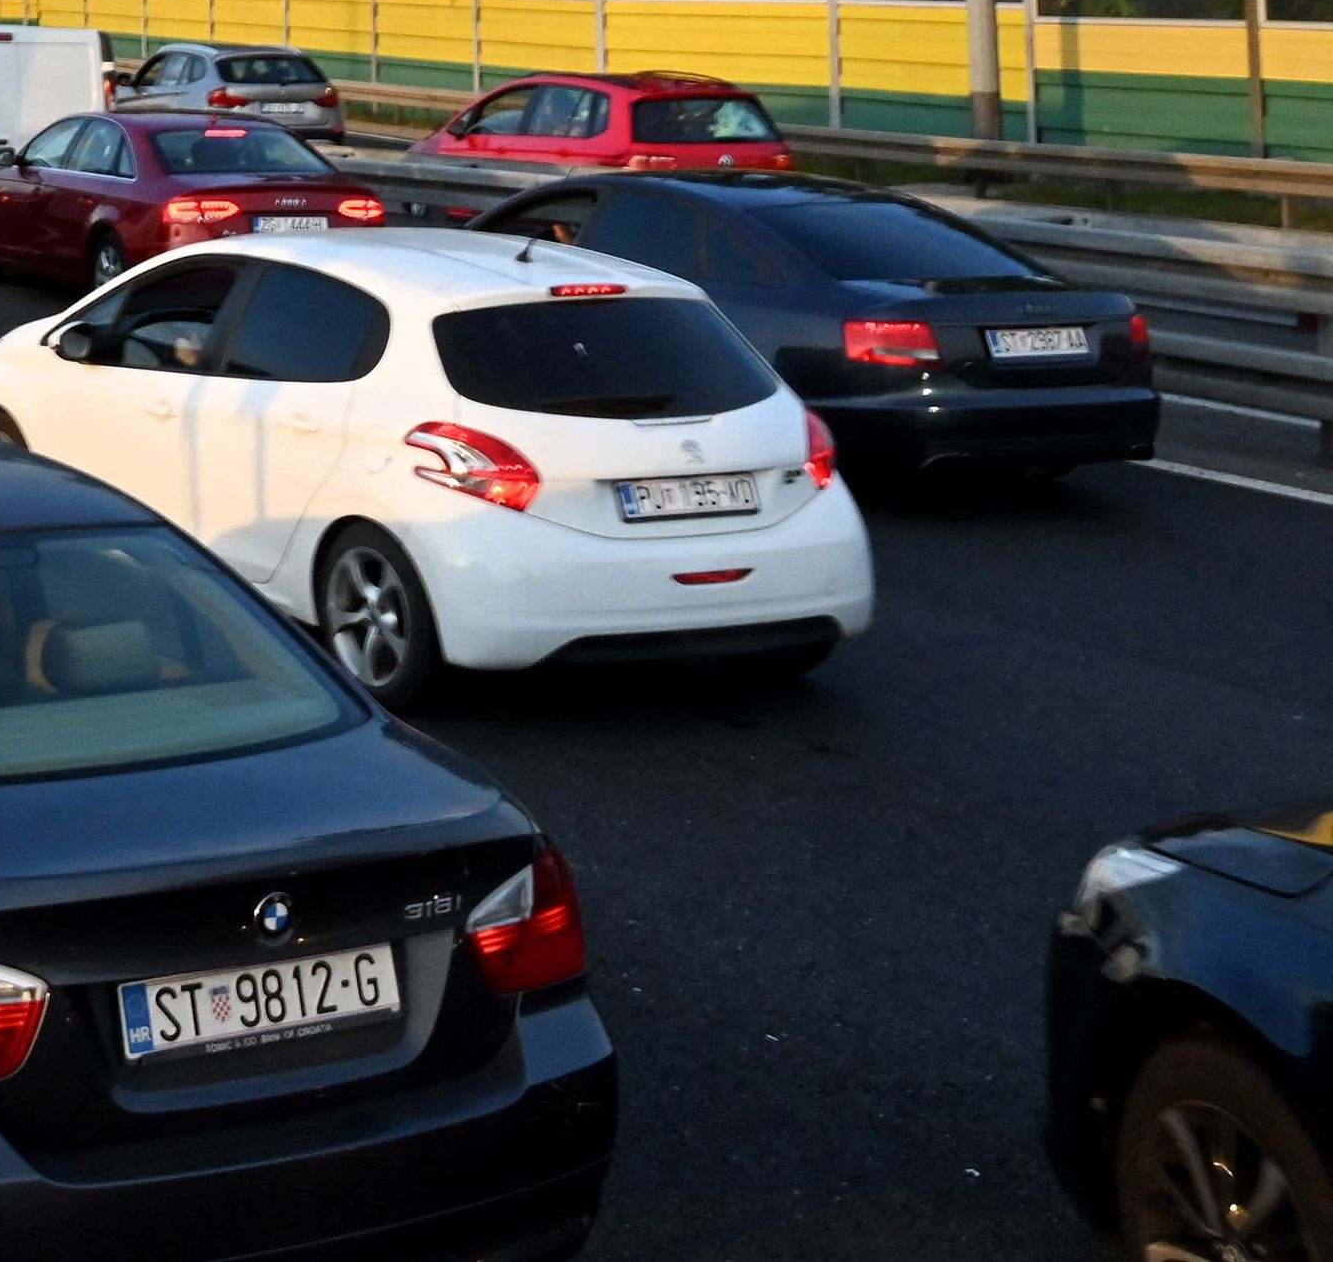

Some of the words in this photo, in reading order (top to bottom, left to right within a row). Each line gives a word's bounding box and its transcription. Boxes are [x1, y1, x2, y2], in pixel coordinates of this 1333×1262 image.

[155, 981, 203, 1042] ST
[235, 952, 380, 1028] 9812-G
[130, 1025, 152, 1042] HR
